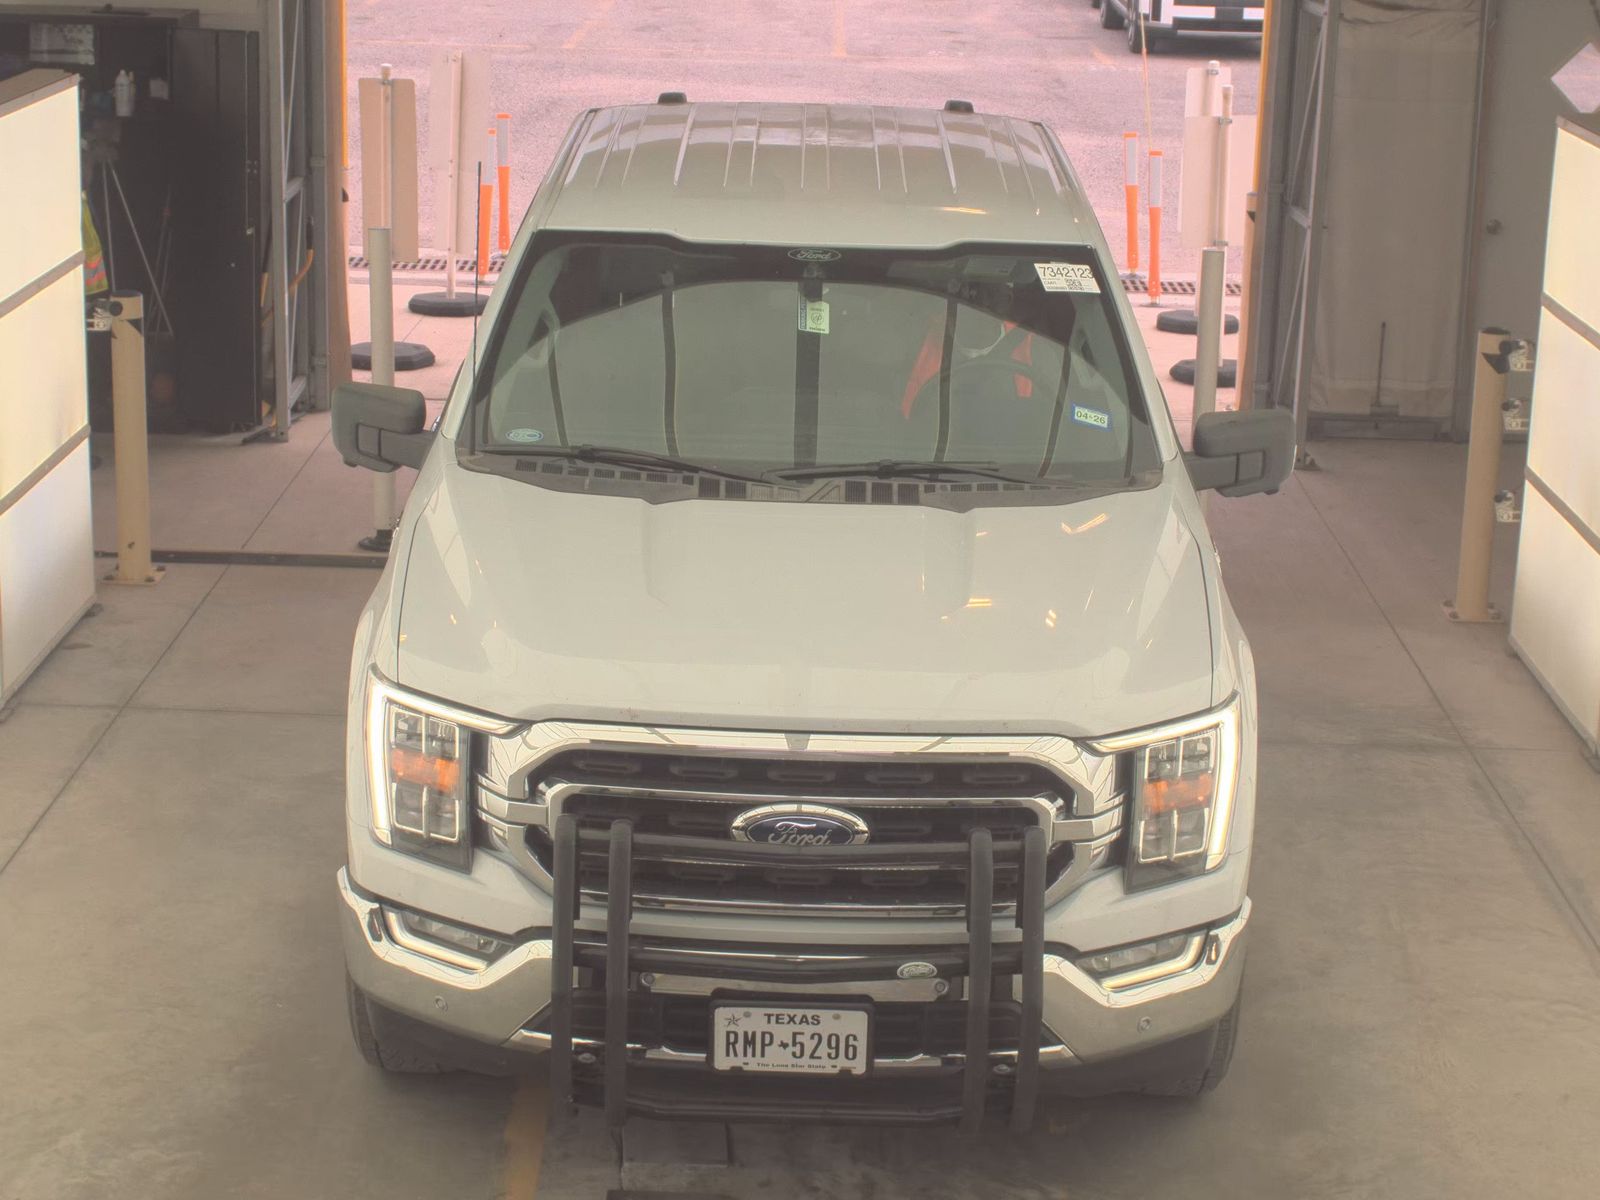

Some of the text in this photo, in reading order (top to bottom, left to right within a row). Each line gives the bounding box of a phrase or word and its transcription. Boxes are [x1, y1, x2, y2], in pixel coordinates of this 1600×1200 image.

[796, 249, 832, 260] Ford
[1039, 266, 1094, 279] 7342123
[767, 821, 832, 846] Ford
[764, 1013, 822, 1026] TEXAS
